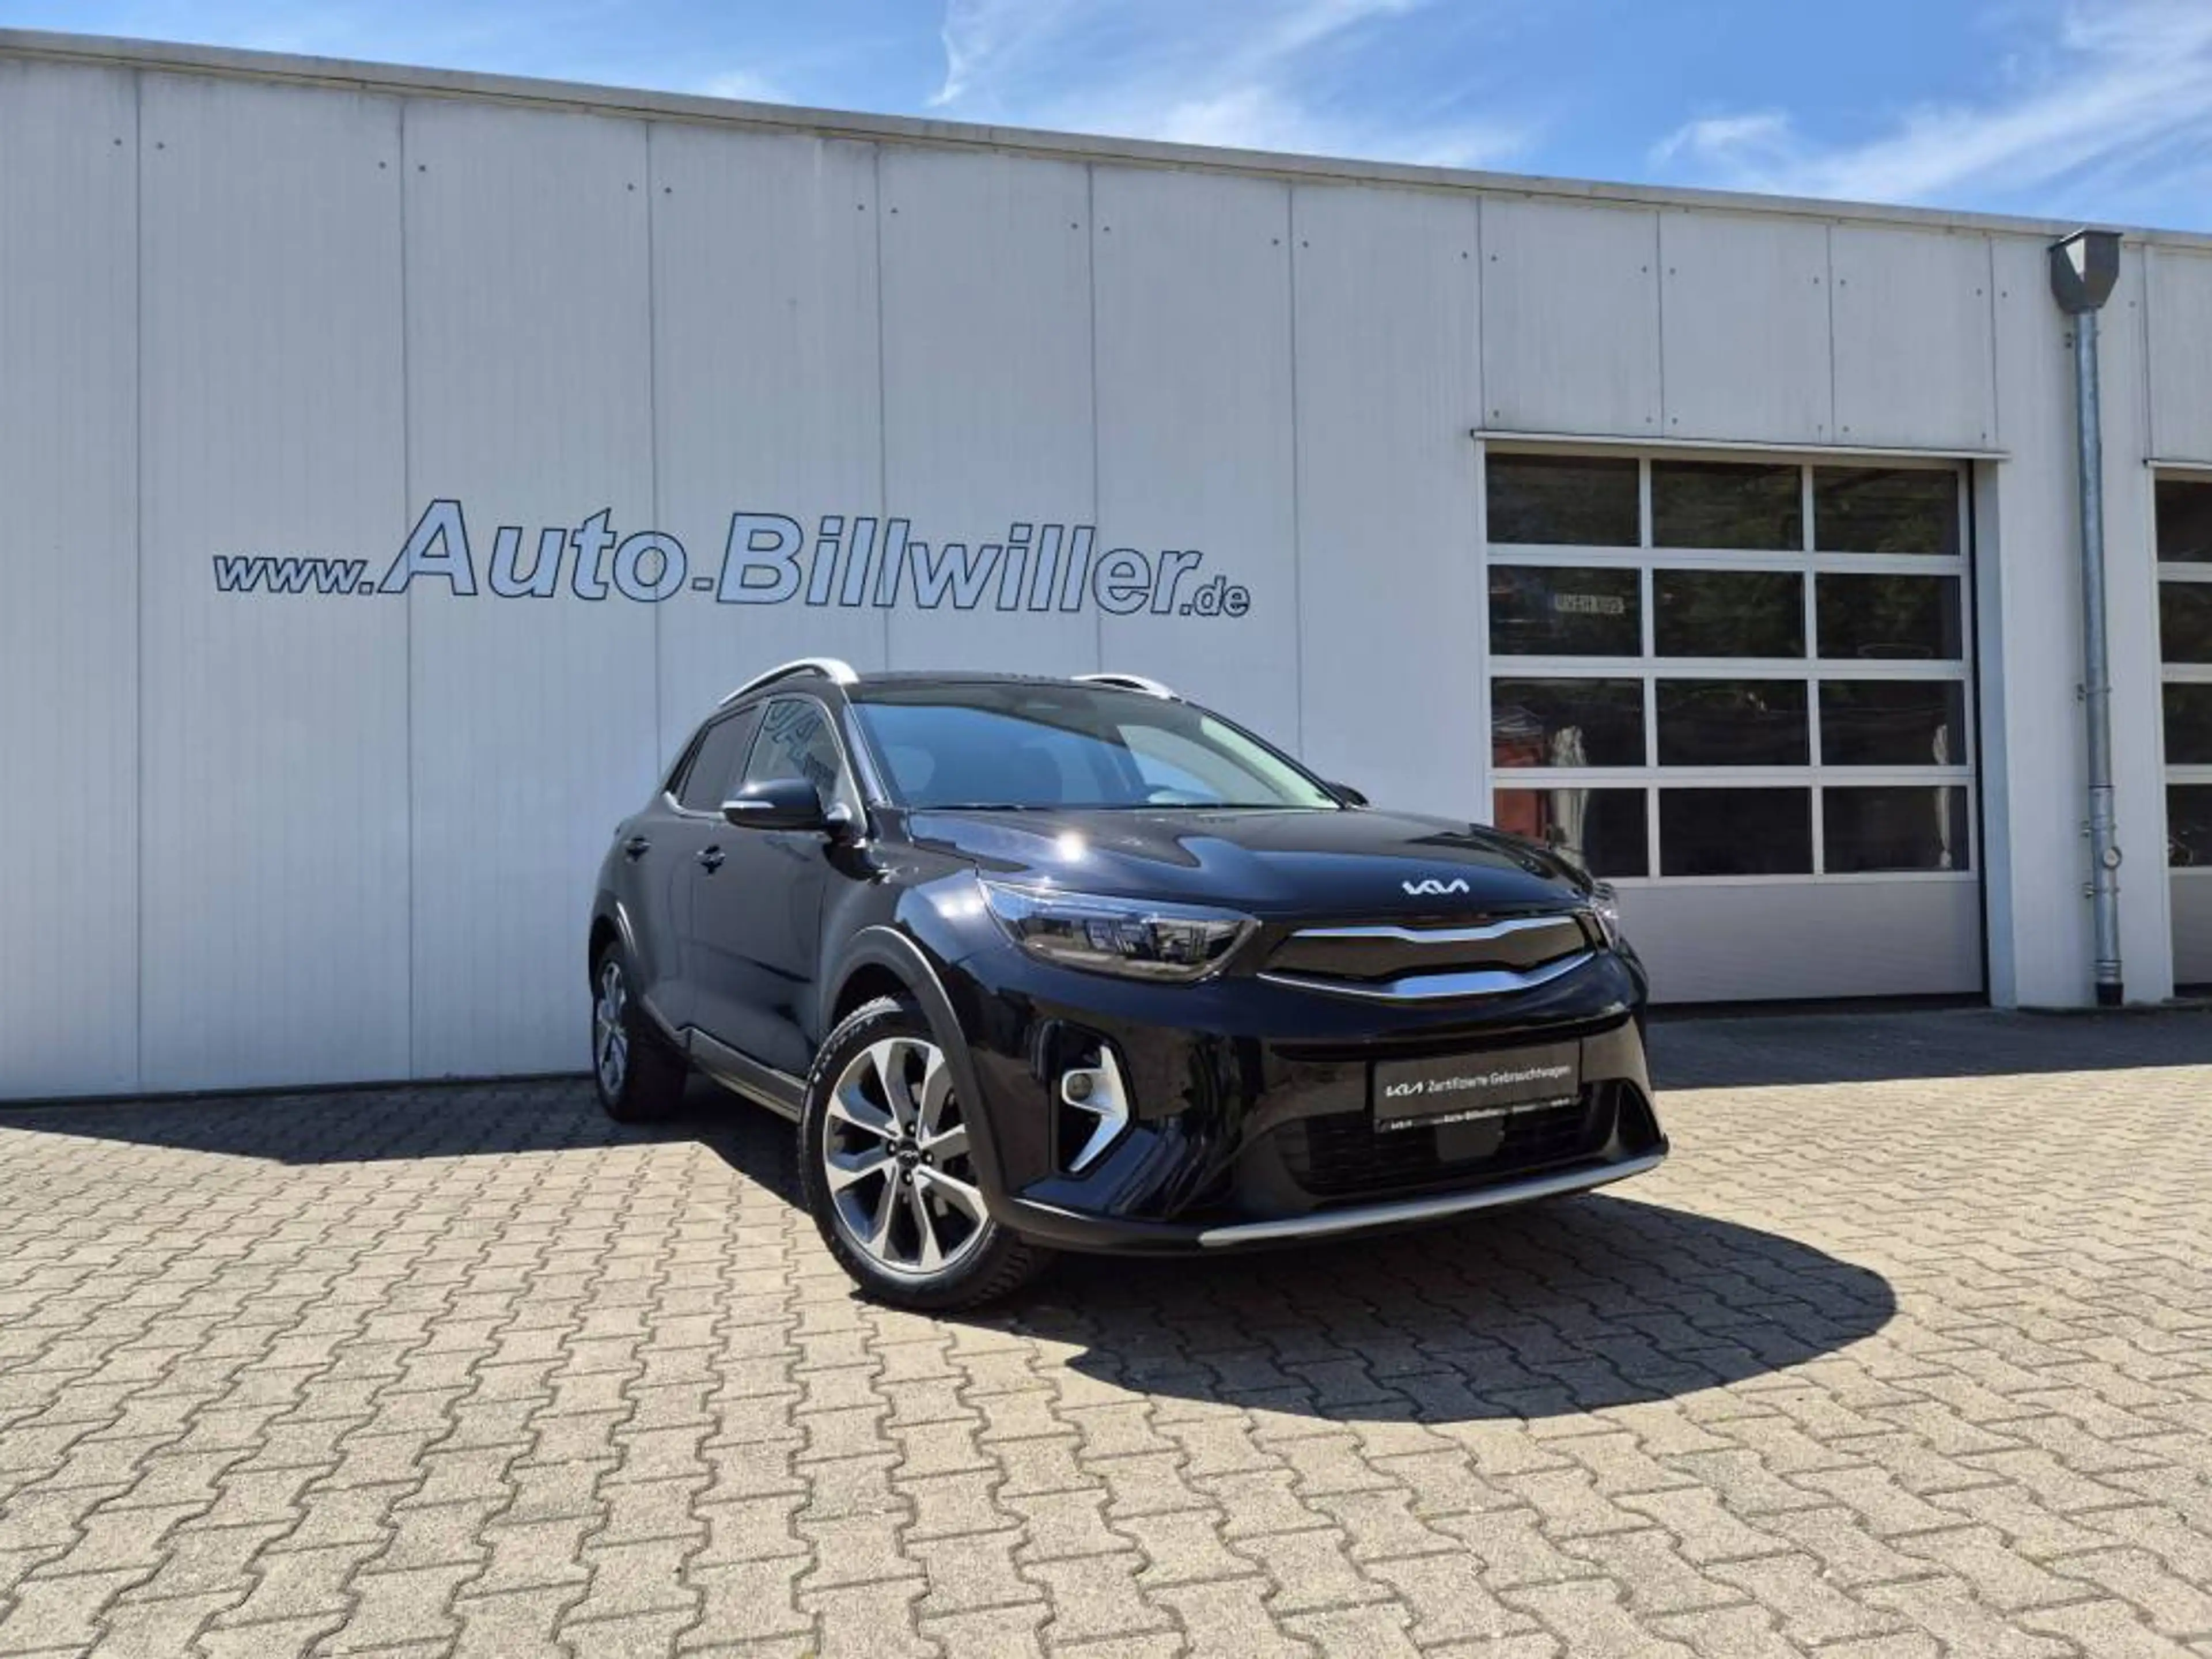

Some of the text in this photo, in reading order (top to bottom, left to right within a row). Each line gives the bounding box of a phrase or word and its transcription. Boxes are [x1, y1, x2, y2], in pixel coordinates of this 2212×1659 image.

[213, 499, 1251, 617] www.Auto-Billwiller.de
[1402, 879, 1469, 895] KIA
[1384, 1081, 1423, 1097] KIA
